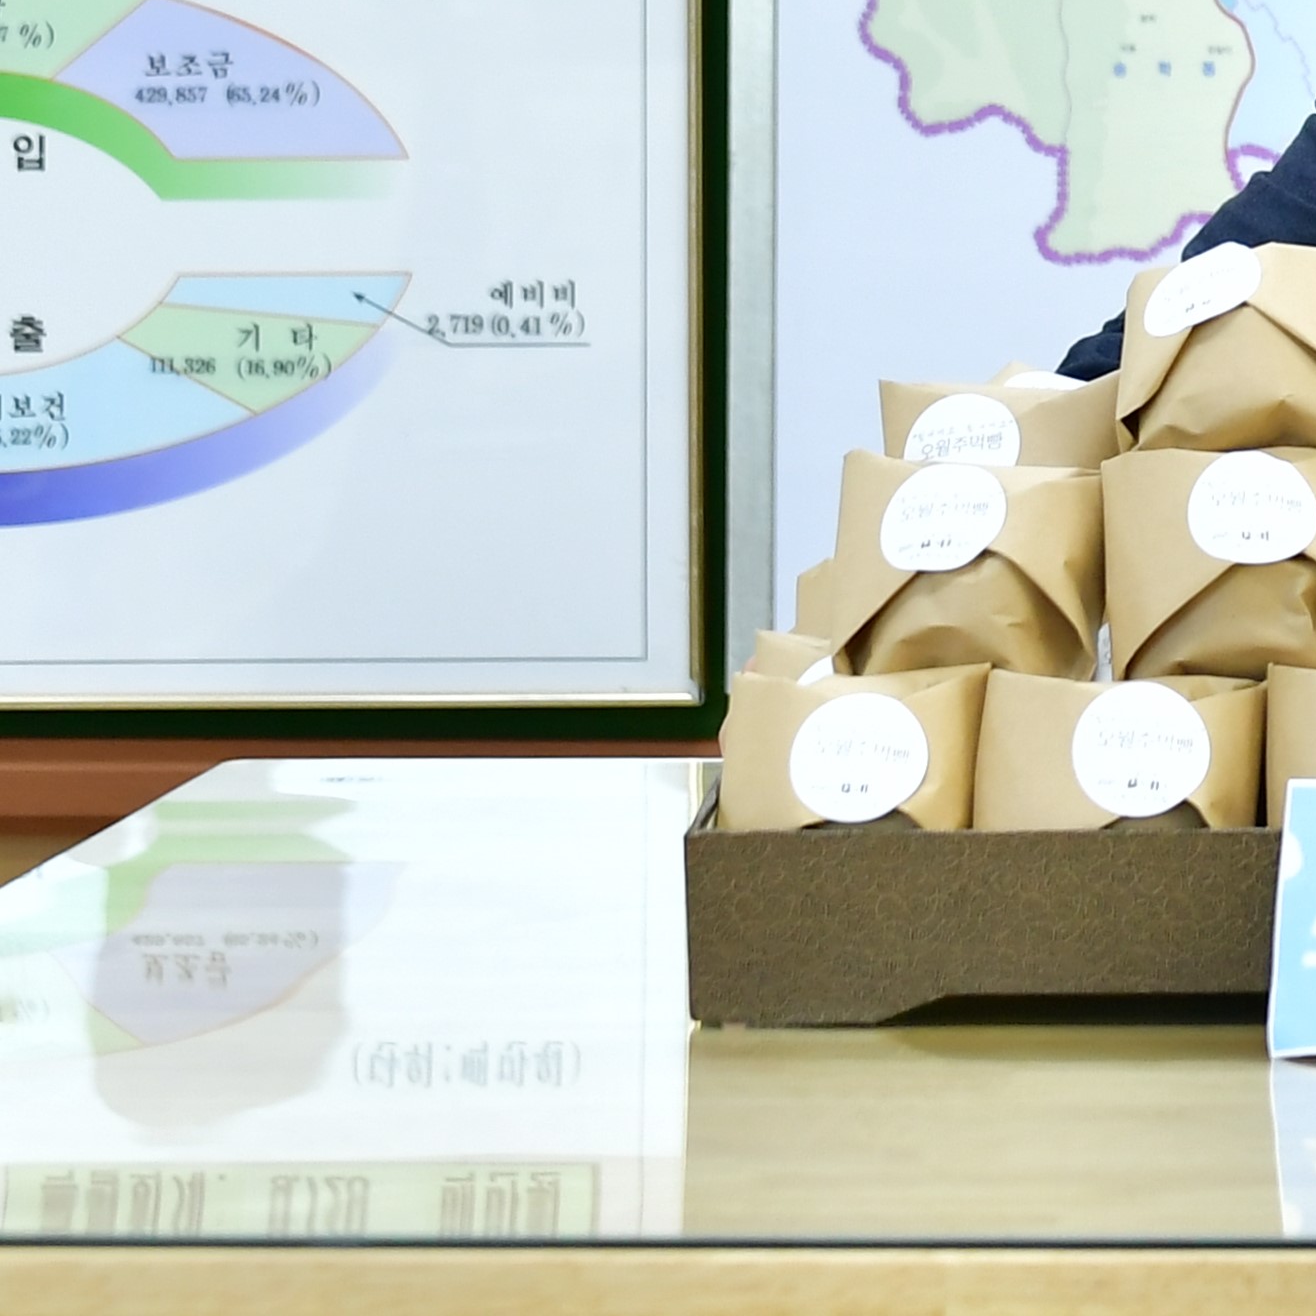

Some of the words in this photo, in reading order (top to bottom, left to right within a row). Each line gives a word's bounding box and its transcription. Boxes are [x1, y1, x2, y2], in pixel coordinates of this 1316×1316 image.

[144, 51, 234, 79] 보조금
[12, 134, 47, 173] 입
[490, 279, 577, 310] 예비비
[10, 315, 47, 354] 출
[236, 324, 319, 352] 기타
